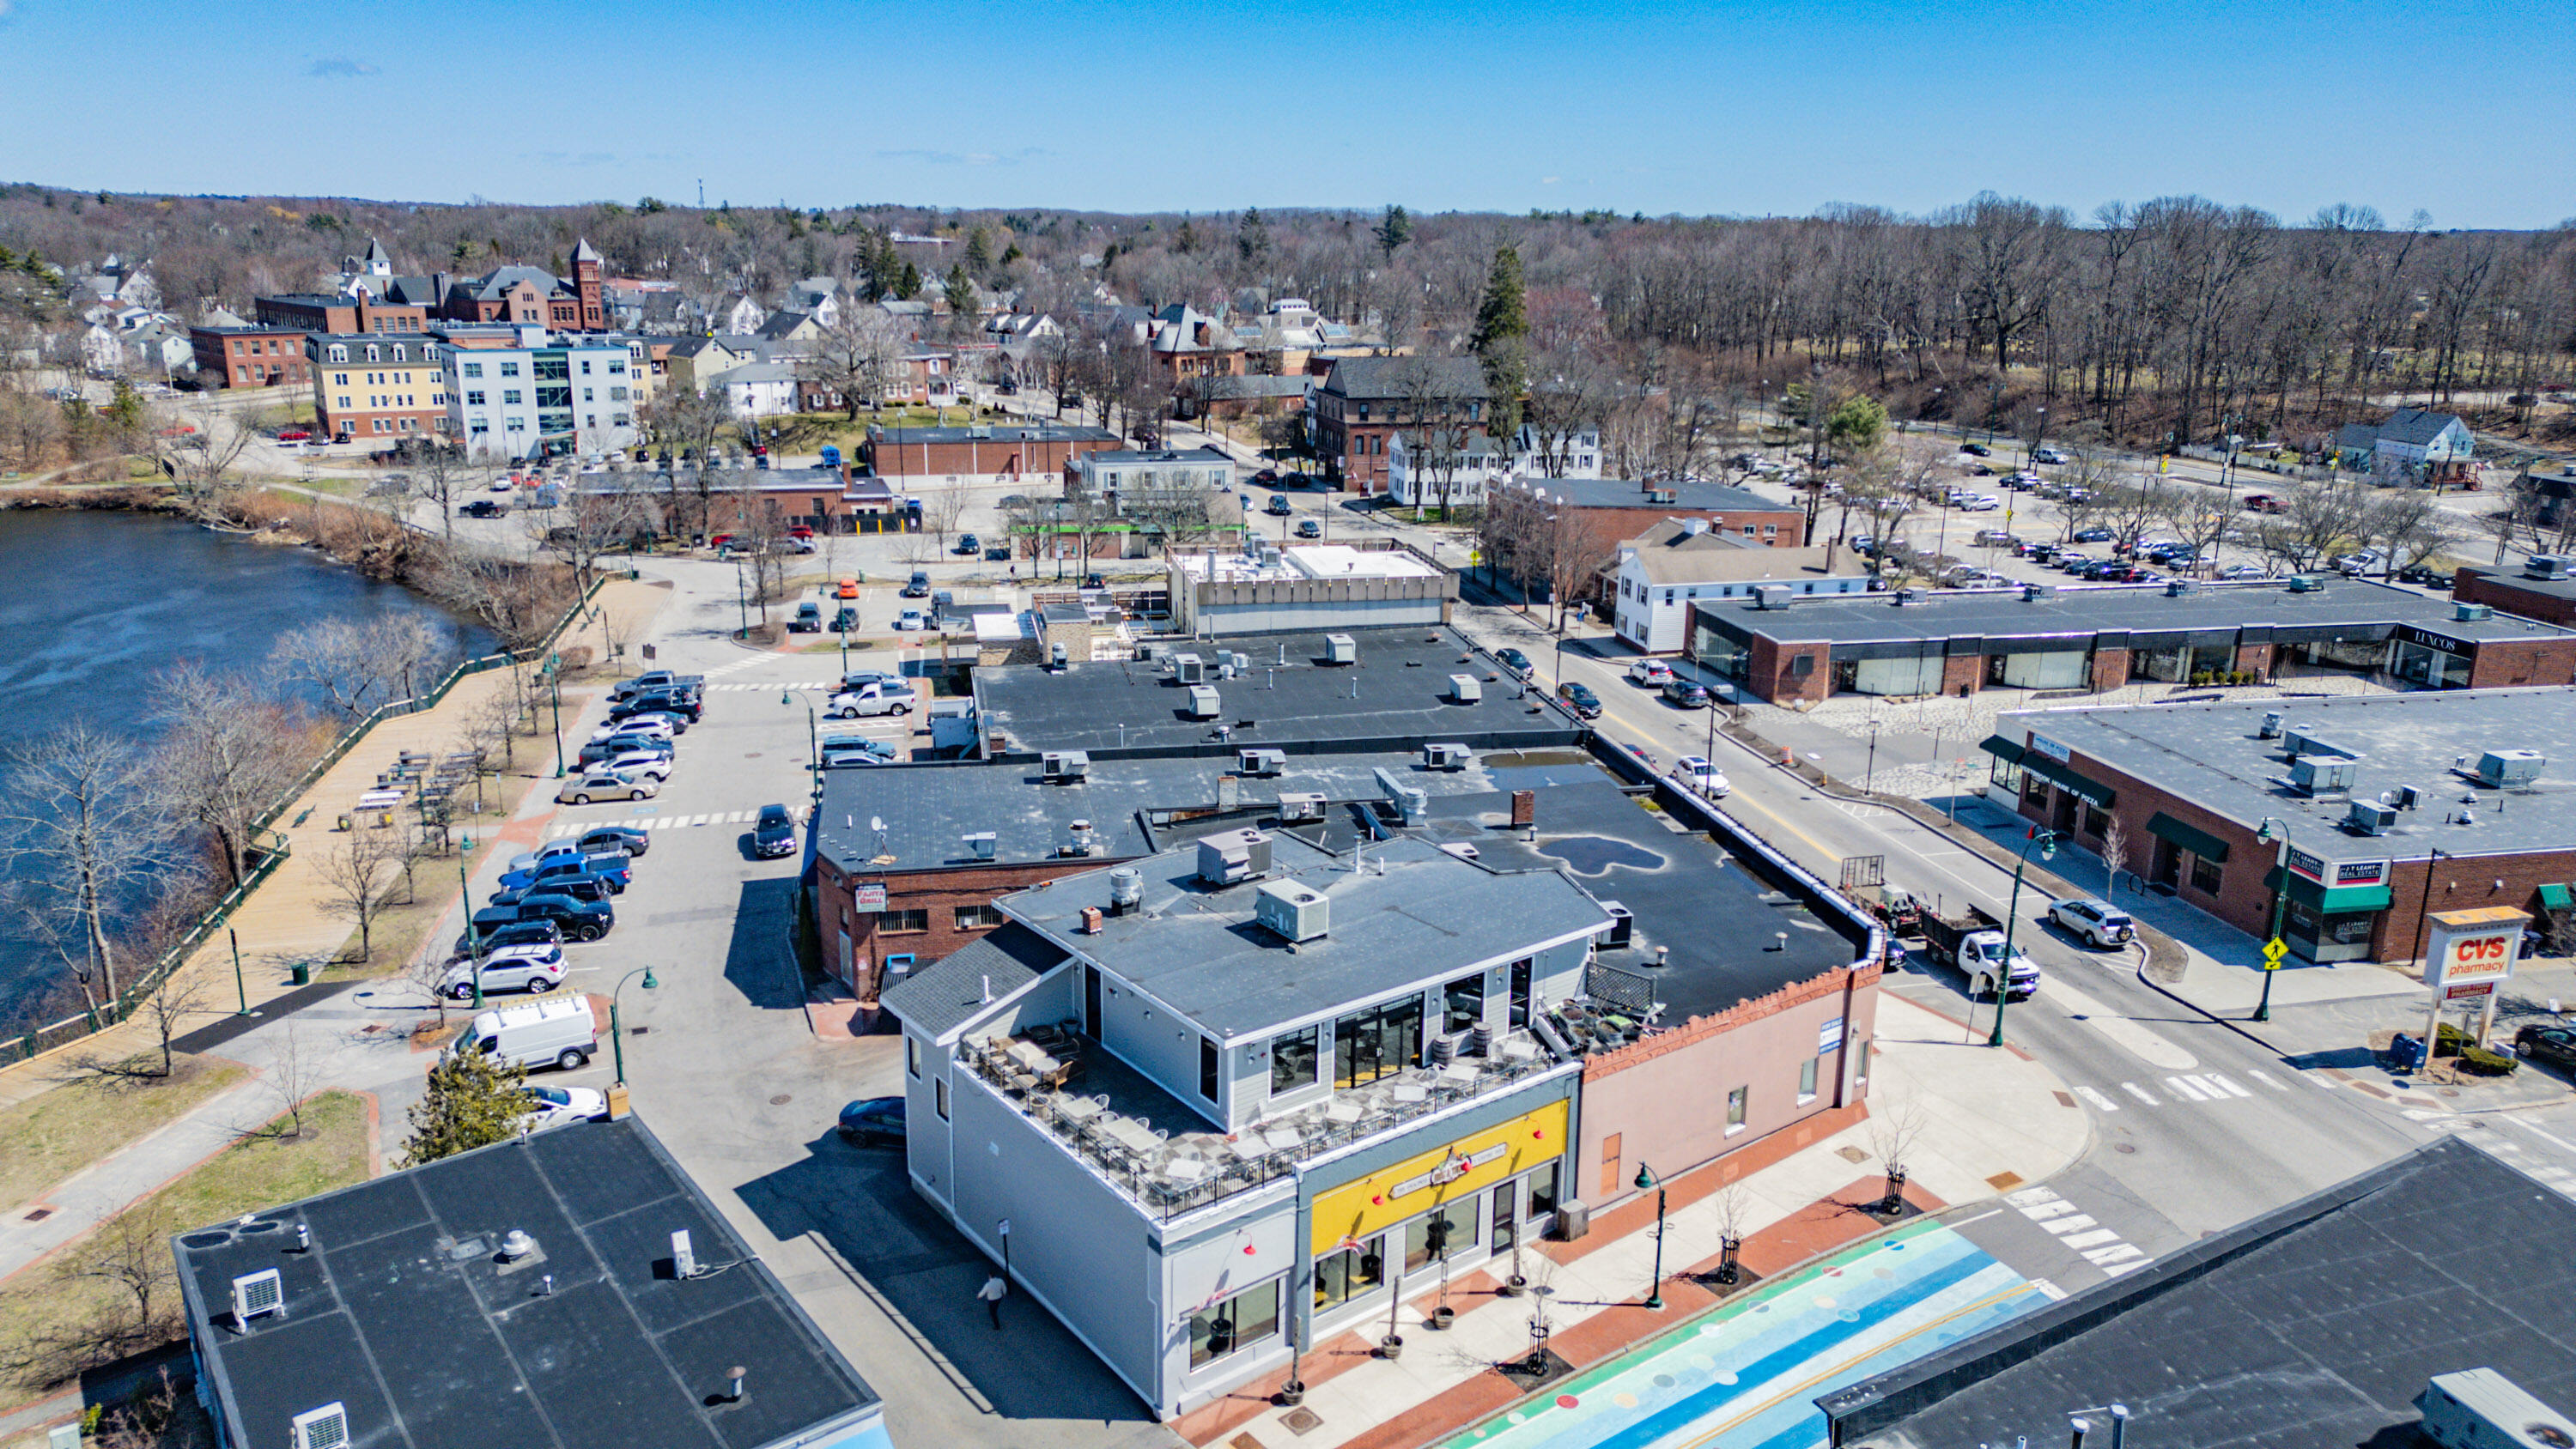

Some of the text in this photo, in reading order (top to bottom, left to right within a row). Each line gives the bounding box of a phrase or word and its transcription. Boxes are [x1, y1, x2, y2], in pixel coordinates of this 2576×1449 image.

[2415, 631, 2456, 652] LUXCOS
[2051, 779, 2069, 792] HOUSE
[2070, 788, 2080, 797] OF
[2081, 793, 2099, 807] PIZZA
[2457, 937, 2506, 961] CVS
[2448, 961, 2505, 978] pharmacy
[2451, 987, 2489, 998] PHARMACY
